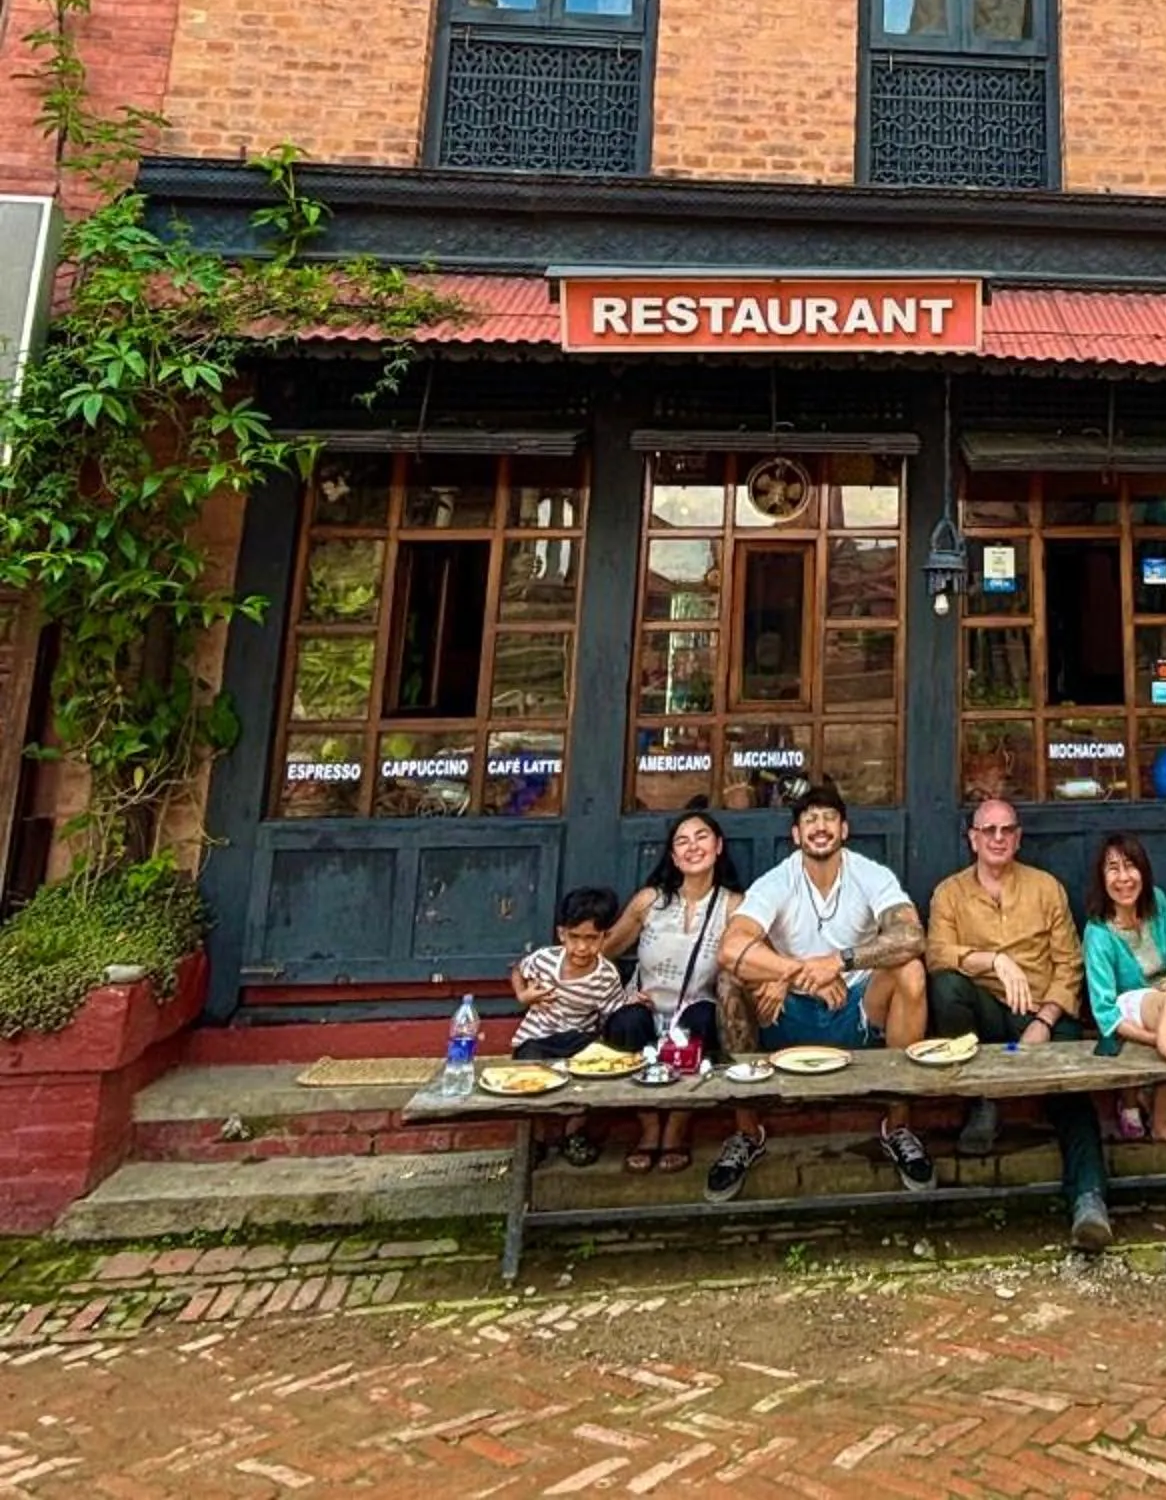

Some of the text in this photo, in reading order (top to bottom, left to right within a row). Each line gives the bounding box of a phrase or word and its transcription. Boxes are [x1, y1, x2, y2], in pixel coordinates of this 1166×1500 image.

[592, 297, 953, 335] RESTAURANT
[733, 751, 804, 768] MACCHIATO
[1048, 742, 1125, 760] MOCHACCINO
[286, 763, 361, 781] ESPRESSO
[381, 759, 469, 777] CAPPUCCINO
[523, 759, 563, 775] LATTE
[638, 755, 711, 772] AMERICANO
